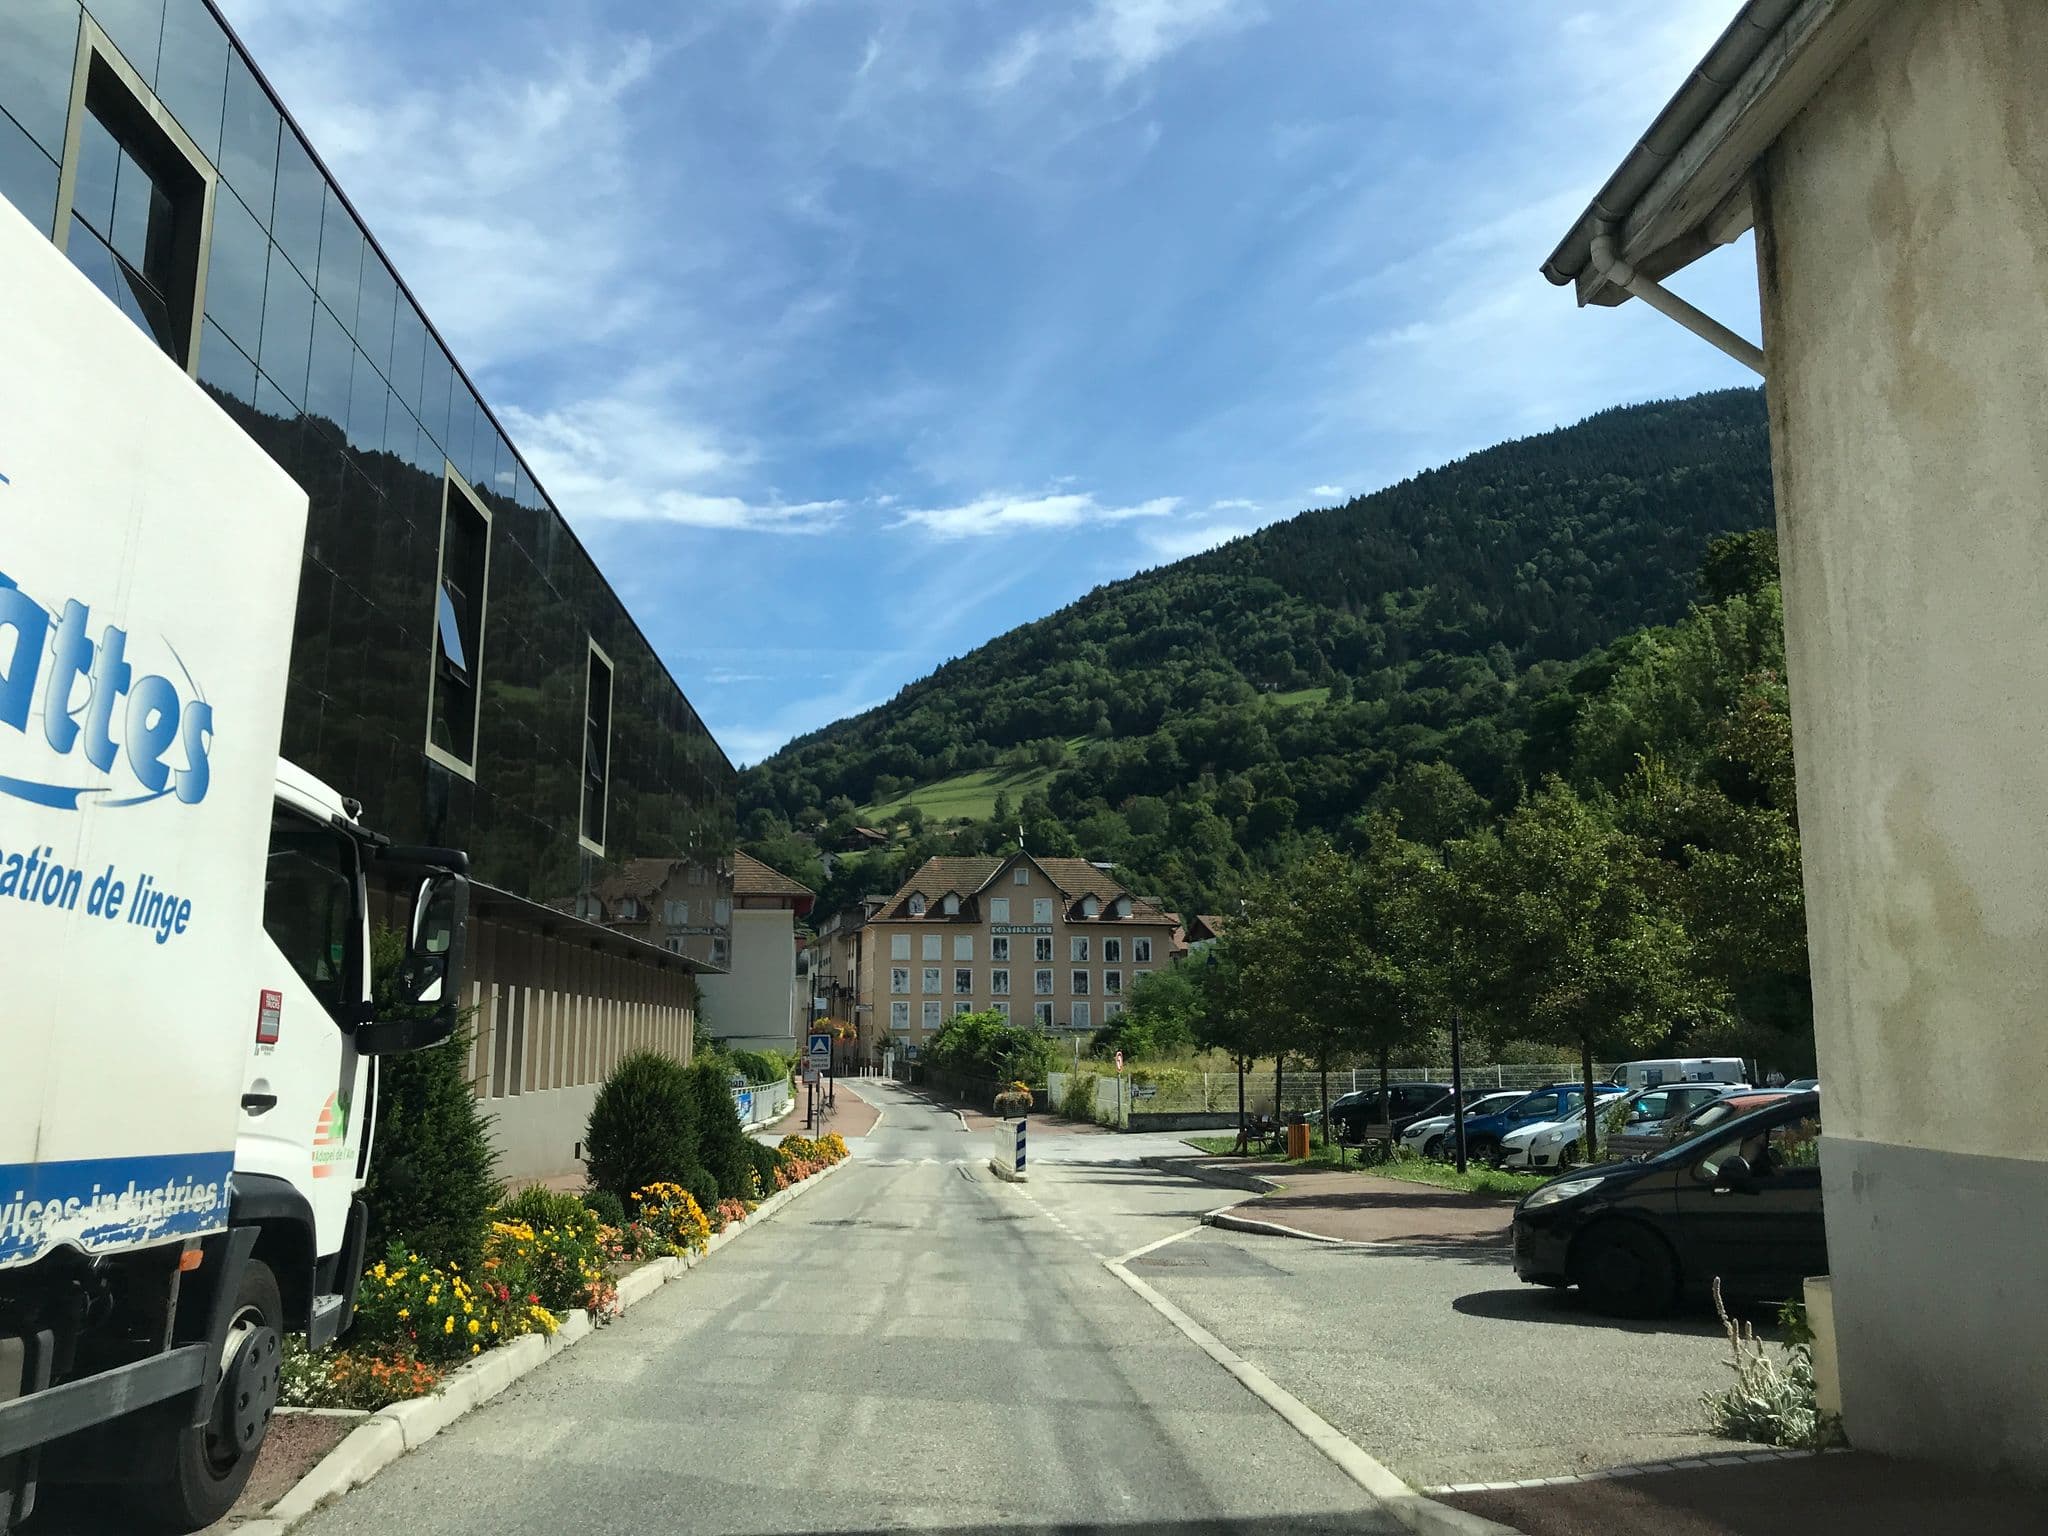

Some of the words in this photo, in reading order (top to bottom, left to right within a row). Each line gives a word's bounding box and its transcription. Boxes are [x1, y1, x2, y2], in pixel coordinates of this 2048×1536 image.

[0, 844, 84, 911] ation
[86, 863, 126, 920] de
[127, 873, 192, 945] linge
